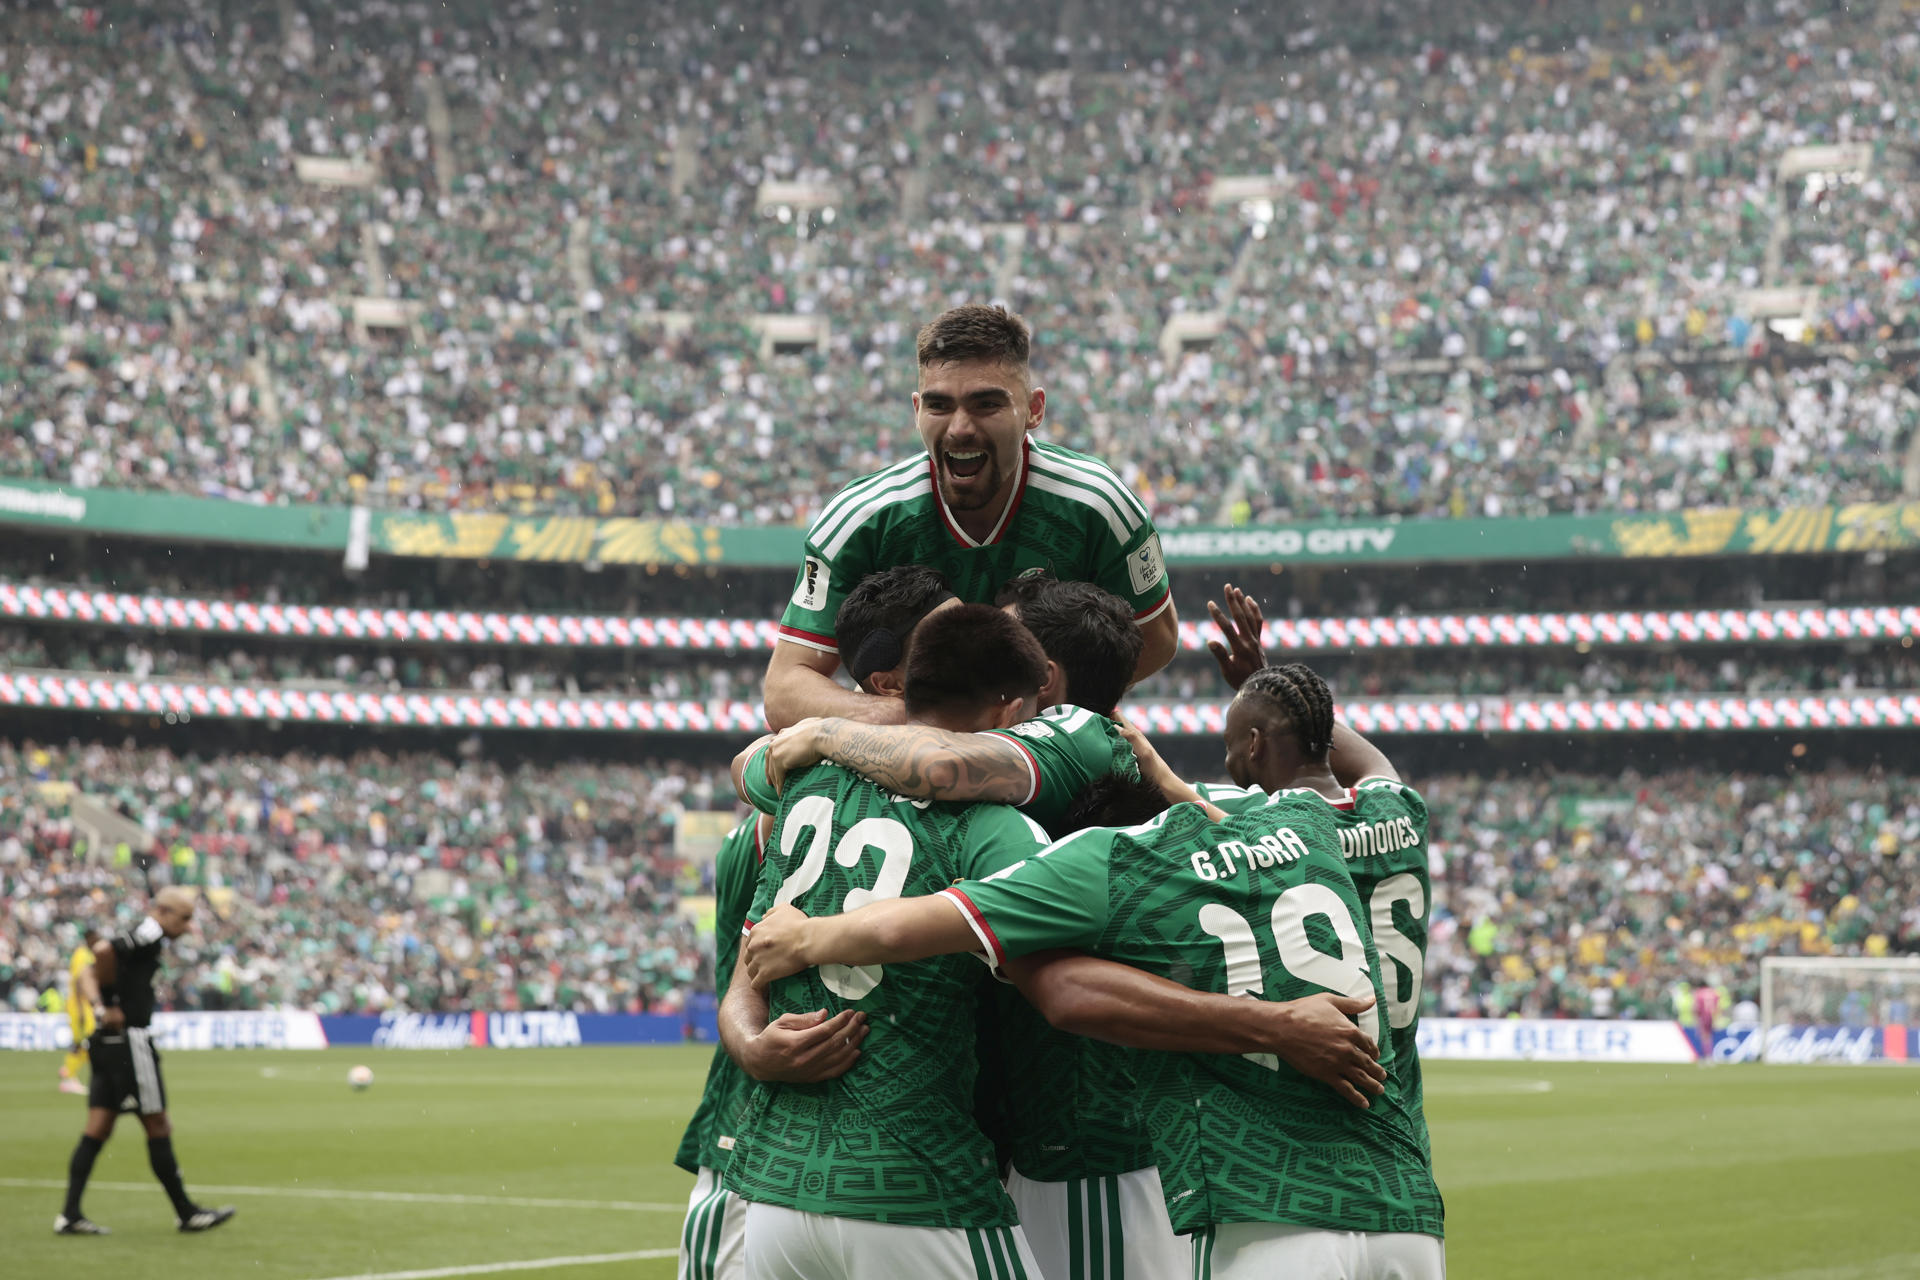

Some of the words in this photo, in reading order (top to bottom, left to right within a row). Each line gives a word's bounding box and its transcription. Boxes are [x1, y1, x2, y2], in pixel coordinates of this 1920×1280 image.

[1161, 529, 1303, 556] MEXICO
[1306, 527, 1396, 554] CITY
[1190, 827, 1310, 881] G.MORA
[1336, 815, 1420, 859] UIÑONES
[1198, 883, 1380, 1072] 19
[488, 1010, 583, 1048] ULTRA
[1514, 1026, 1632, 1053] BEER
